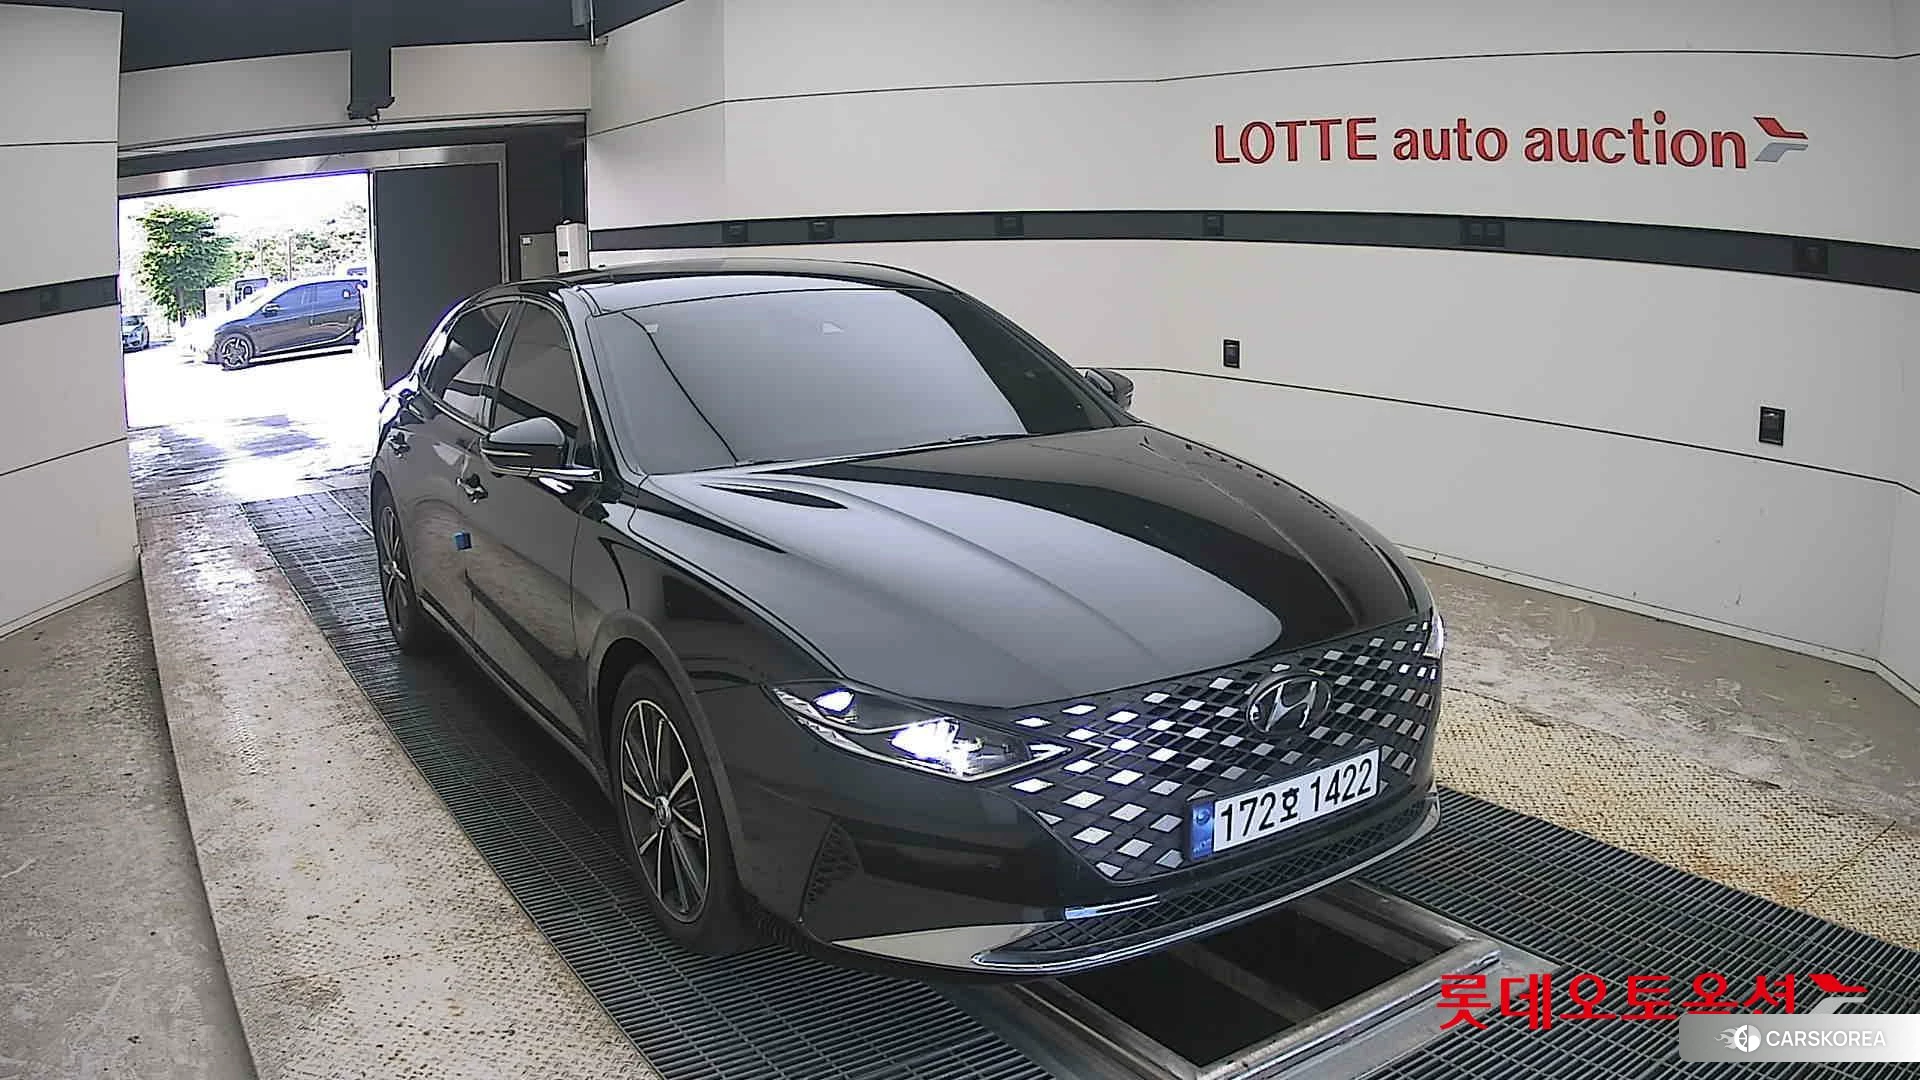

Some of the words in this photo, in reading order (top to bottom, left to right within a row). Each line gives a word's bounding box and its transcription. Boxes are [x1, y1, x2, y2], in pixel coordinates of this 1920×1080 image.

[1215, 117, 1377, 163] LOTTE
[1393, 118, 1508, 161] auto
[1524, 111, 1747, 168] auction
[1221, 788, 1300, 842] 172호
[1310, 758, 1372, 812] 1422
